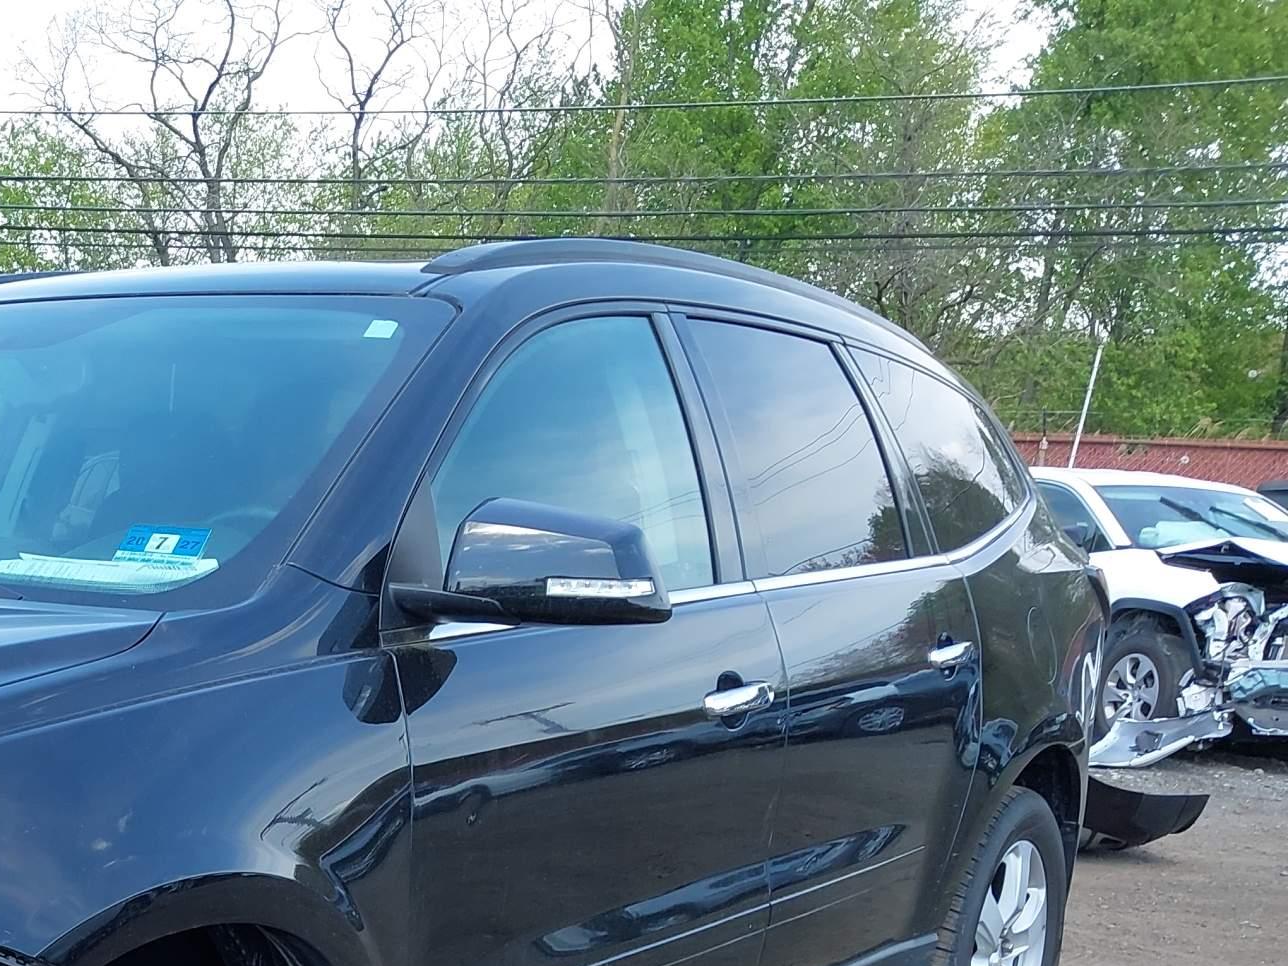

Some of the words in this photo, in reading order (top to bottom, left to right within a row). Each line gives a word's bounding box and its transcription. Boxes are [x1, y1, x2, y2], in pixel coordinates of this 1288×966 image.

[126, 536, 146, 546] 20
[154, 536, 170, 551] 7
[178, 540, 201, 551] 27
